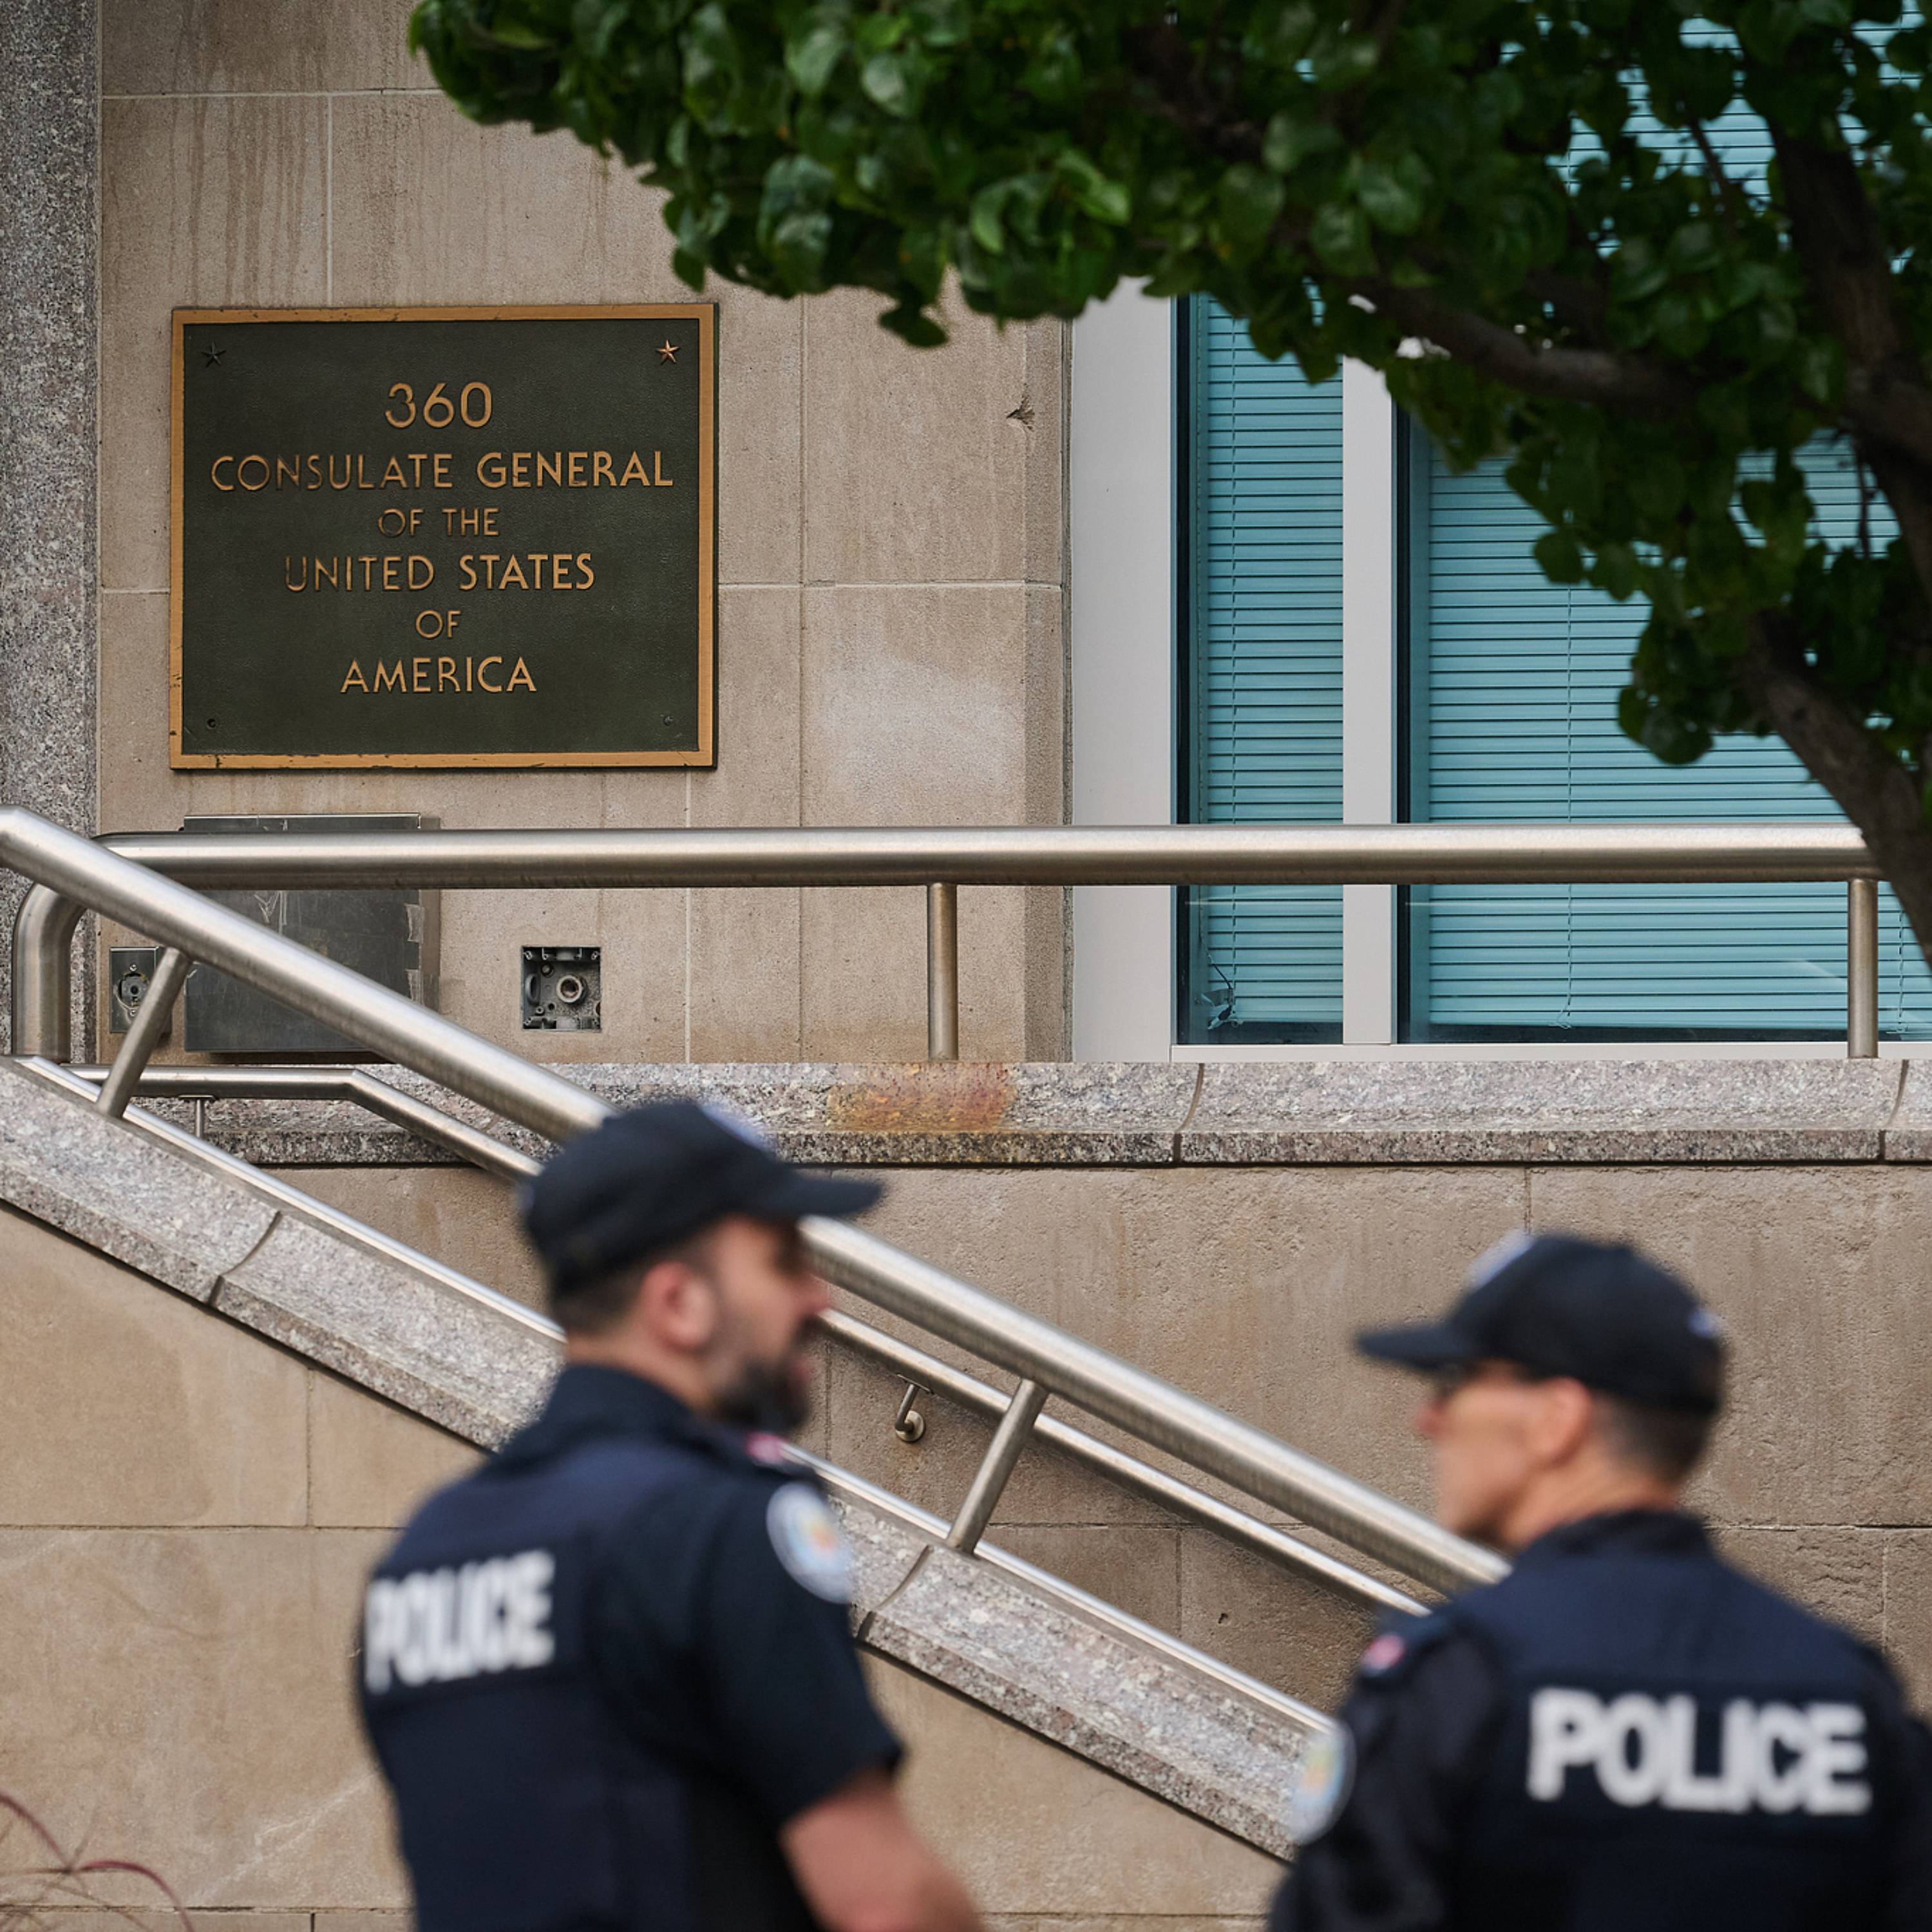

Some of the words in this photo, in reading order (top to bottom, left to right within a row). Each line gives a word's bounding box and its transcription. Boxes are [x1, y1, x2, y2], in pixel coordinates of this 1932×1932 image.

[384, 381, 492, 428] 360
[211, 453, 453, 490] CONSULATE
[477, 451, 674, 488] GENERAL
[378, 508, 422, 537] OF
[442, 507, 500, 536] THE
[285, 555, 435, 592] UNITED
[459, 553, 596, 591] STATES
[415, 610, 462, 639] OF
[341, 656, 538, 693] AMERICA
[365, 1550, 556, 1694] POLICE
[1528, 1687, 1871, 1814] POLICE
